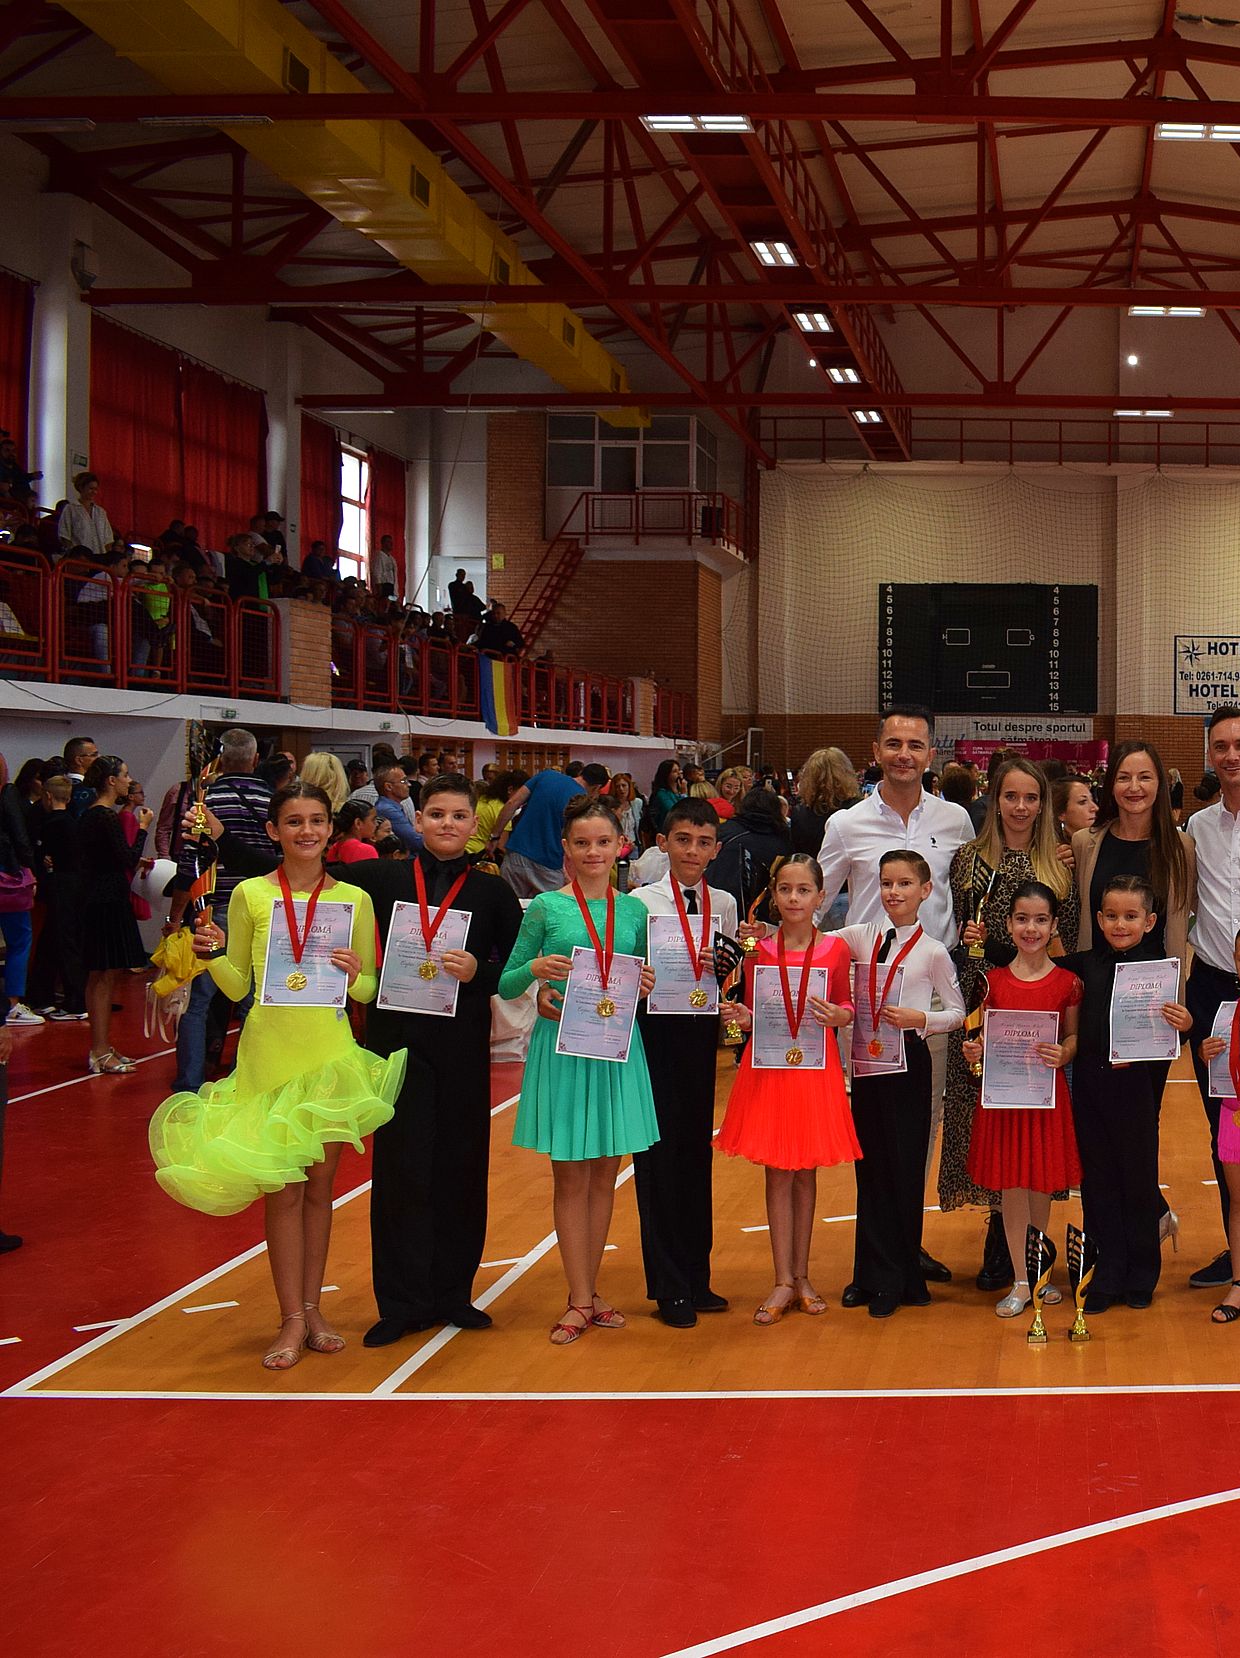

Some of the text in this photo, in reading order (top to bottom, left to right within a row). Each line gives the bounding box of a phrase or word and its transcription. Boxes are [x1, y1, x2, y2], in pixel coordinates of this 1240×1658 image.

[886, 585, 893, 593] 4
[1053, 586, 1060, 594] 4
[886, 596, 893, 604] 5
[1053, 596, 1060, 605] 5
[886, 606, 893, 615] 6
[1053, 607, 1060, 616] 6
[886, 617, 893, 625] 7
[1053, 618, 1060, 626] 7
[886, 628, 893, 636] 8
[1053, 628, 1060, 637] 8
[886, 638, 893, 646] 9
[1053, 639, 1060, 647] 9
[882, 649, 893, 657] 10
[1049, 650, 1060, 658] 10
[882, 660, 893, 668] 11
[1049, 660, 1060, 669] 11
[882, 671, 893, 679] 12
[1049, 671, 1060, 680] 12
[1179, 671, 1194, 681] Tel:
[882, 681, 893, 689] 13
[1049, 681, 1060, 690] 13
[1189, 683, 1239, 698] HOTEL
[882, 692, 893, 700] 14
[1049, 692, 1060, 701] 14
[1049, 703, 1060, 711] 15
[1207, 701, 1221, 710] Tel:
[973, 721, 1086, 734] Totul despre sportul
[1004, 1029, 1040, 1038] DIPLOMĂ
